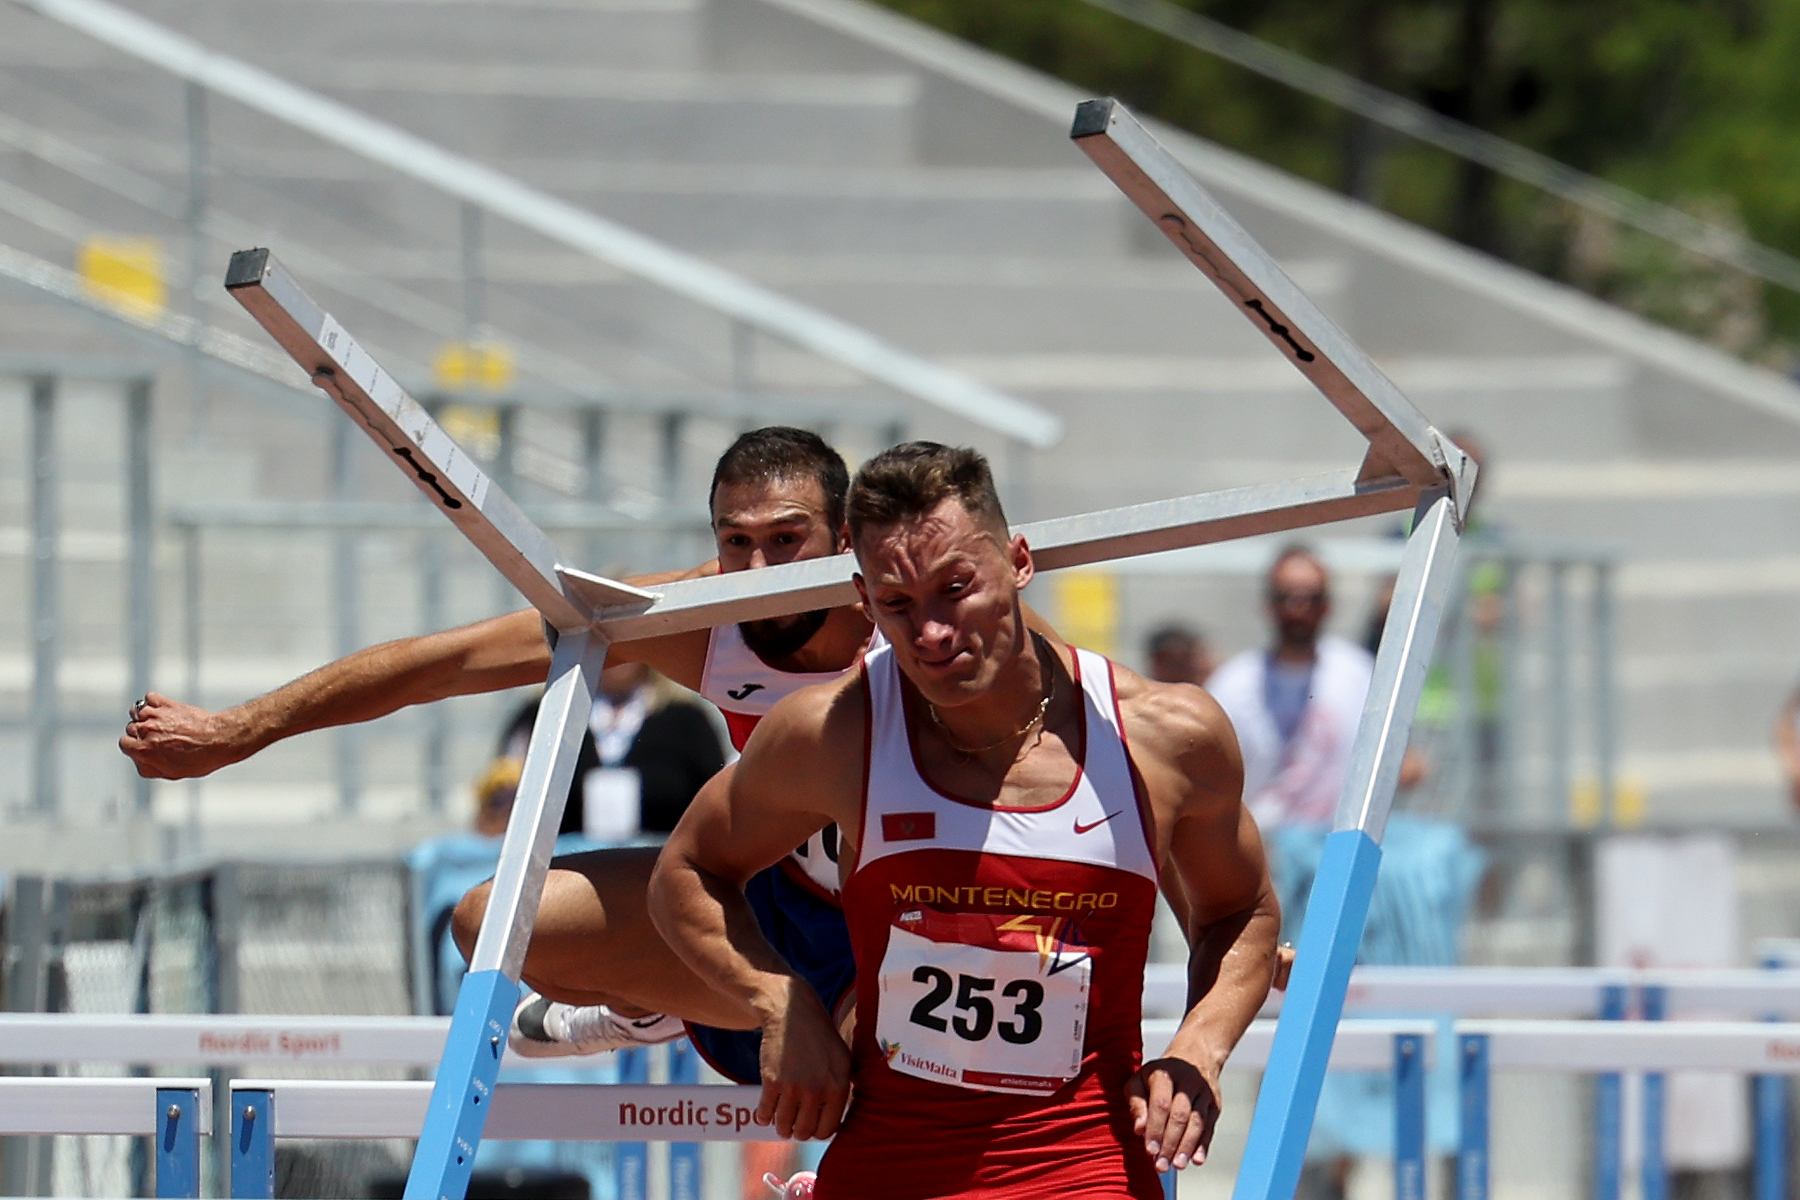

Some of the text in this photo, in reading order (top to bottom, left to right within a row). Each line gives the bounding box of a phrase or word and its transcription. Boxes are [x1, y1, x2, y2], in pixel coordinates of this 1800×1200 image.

[890, 883, 1118, 910] MONTENEGRO
[909, 965, 1044, 1045] 253
[901, 1053, 957, 1080] VisitMalta
